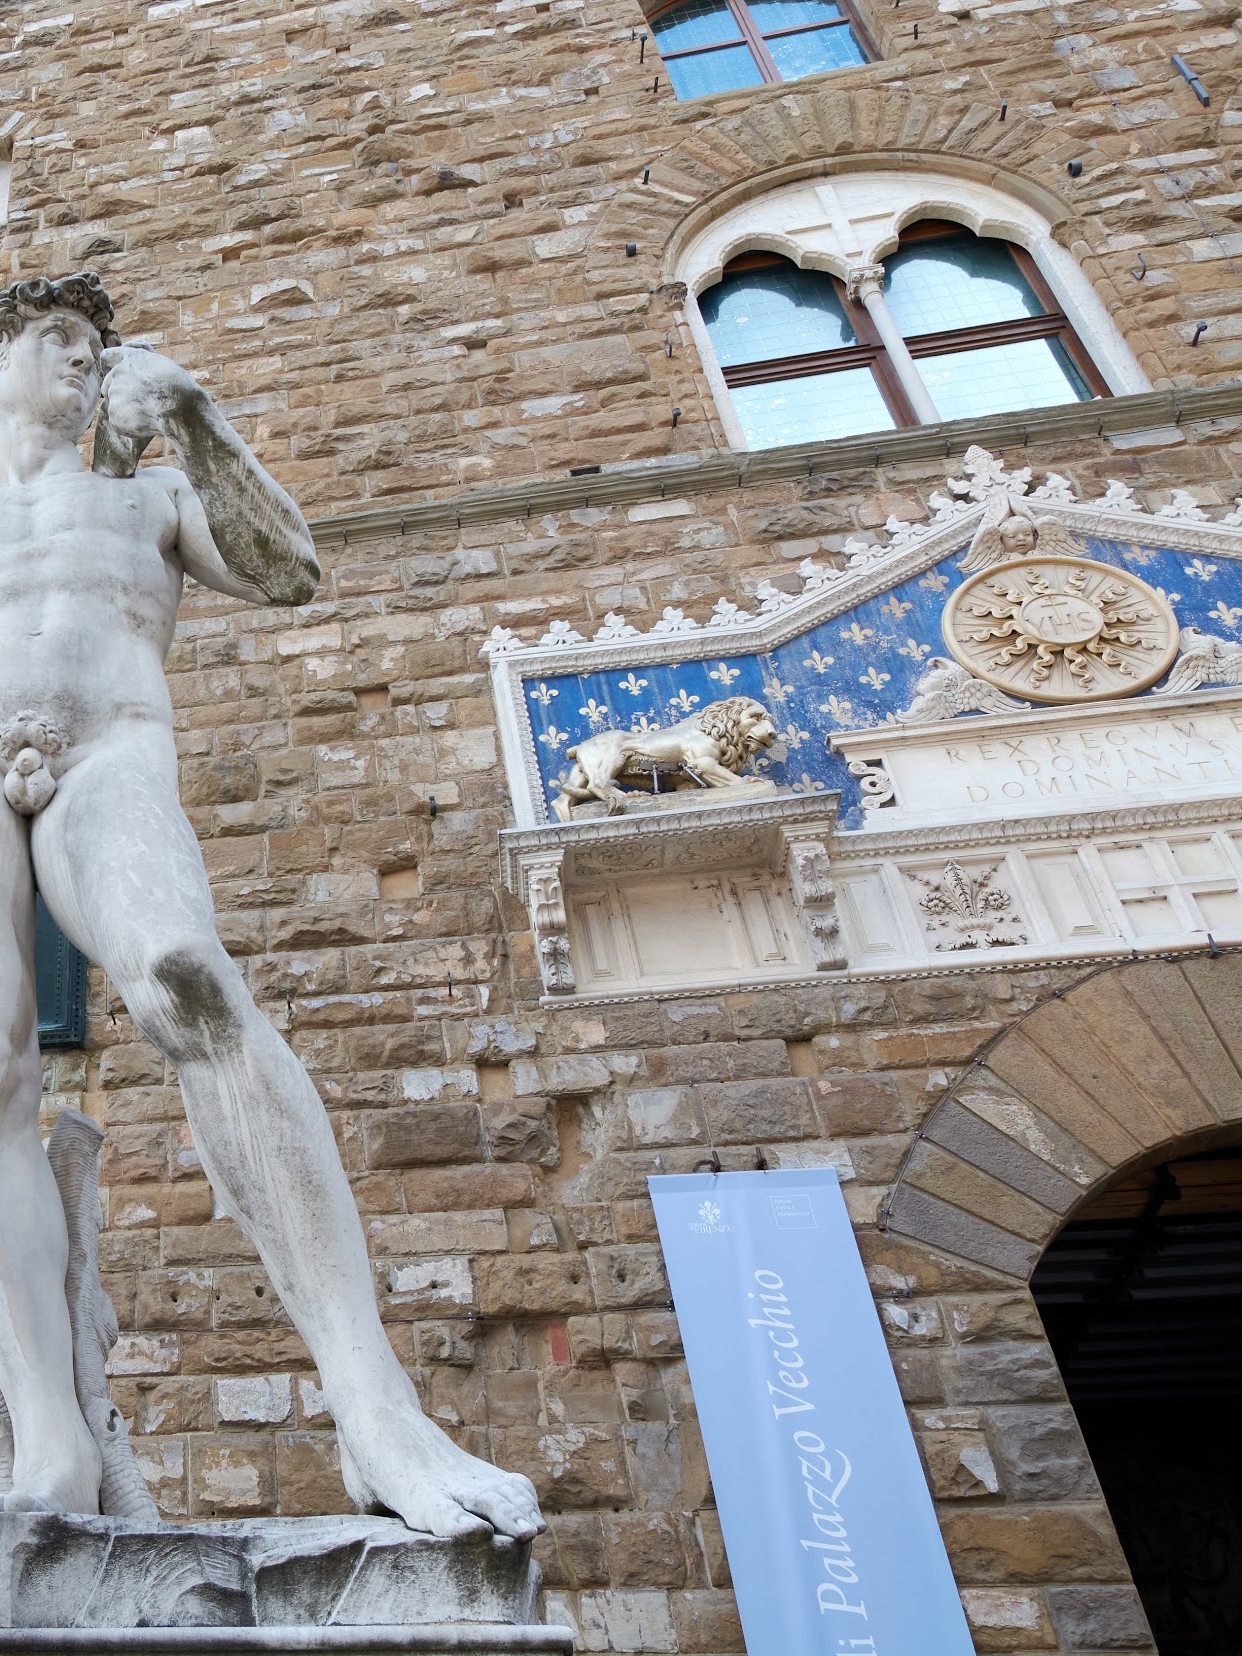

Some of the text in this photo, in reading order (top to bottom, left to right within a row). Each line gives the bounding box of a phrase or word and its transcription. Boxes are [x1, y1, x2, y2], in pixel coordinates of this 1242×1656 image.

[946, 739, 1029, 764] REX
[1046, 721, 1203, 753] REGVM
[1016, 739, 1226, 777] DOMINVS
[694, 1223, 733, 1235] FIRENZE
[748, 1269, 815, 1420] Vecchio
[794, 1431, 868, 1621] Palazzo
